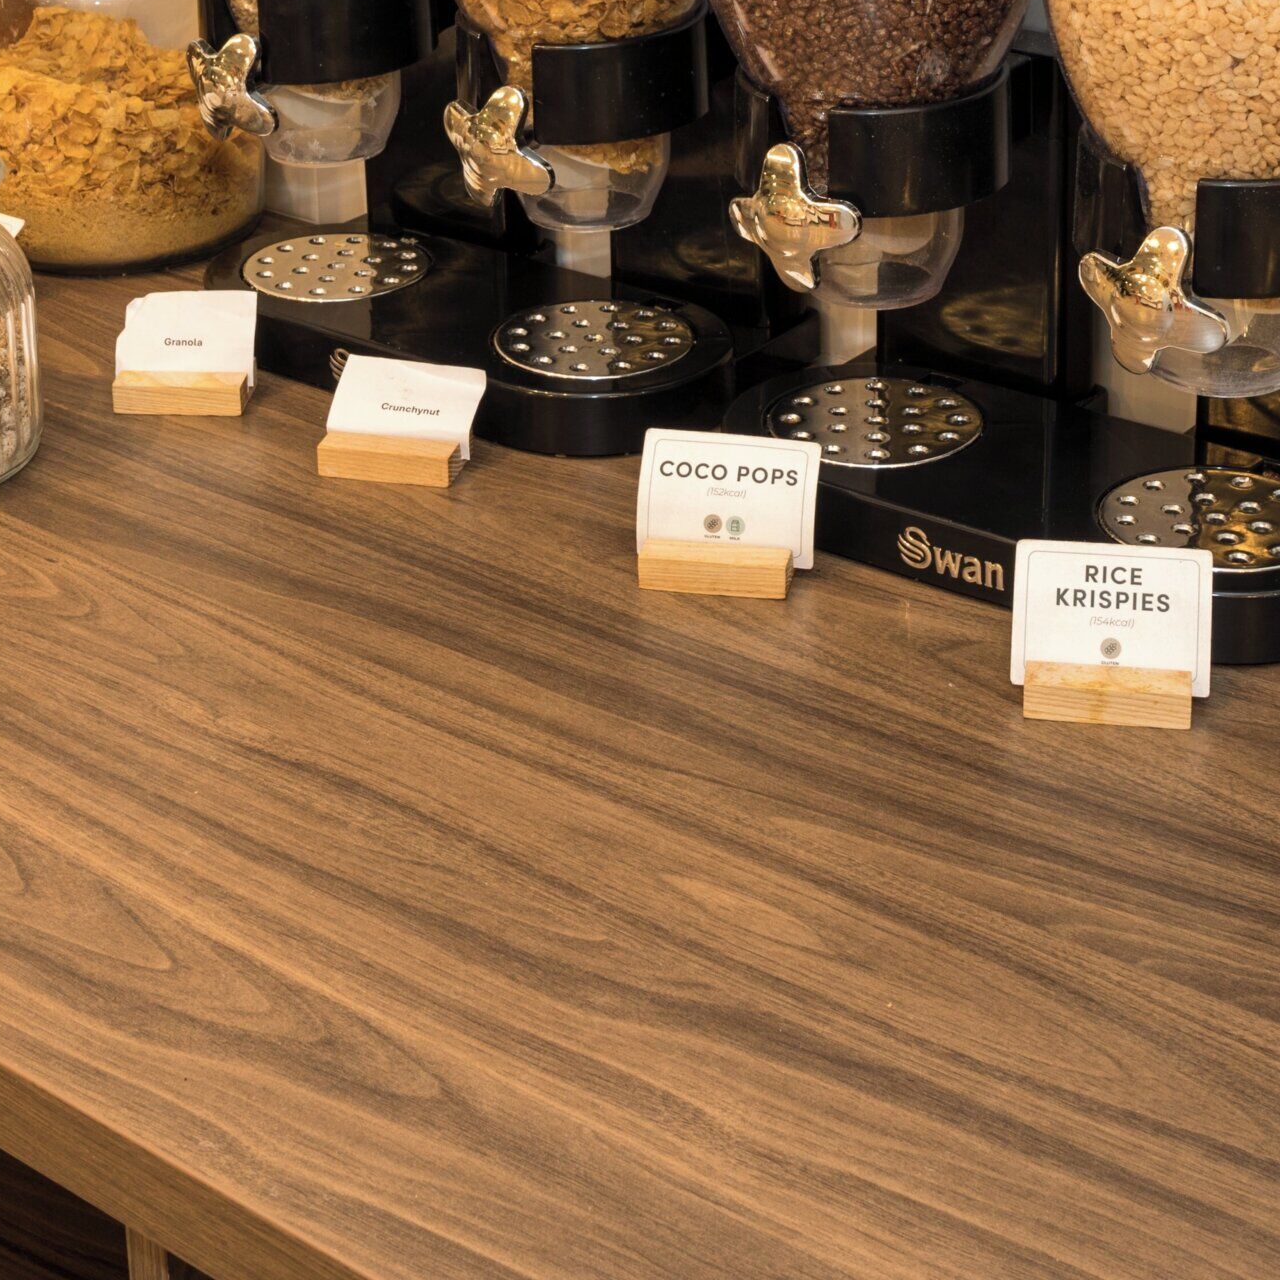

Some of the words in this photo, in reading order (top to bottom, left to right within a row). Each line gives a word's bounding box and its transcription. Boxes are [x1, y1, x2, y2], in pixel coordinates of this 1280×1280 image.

[164, 337, 203, 347] Granola
[381, 402, 440, 416] Crunchynut
[660, 460, 728, 481] COCO
[737, 465, 798, 486] POPS
[707, 487, 747, 499] (152kcal)
[897, 526, 1005, 592] Swan
[1085, 564, 1143, 586] RICE
[1056, 588, 1170, 613] KRISPIES
[1090, 616, 1135, 629] (154kcal)
